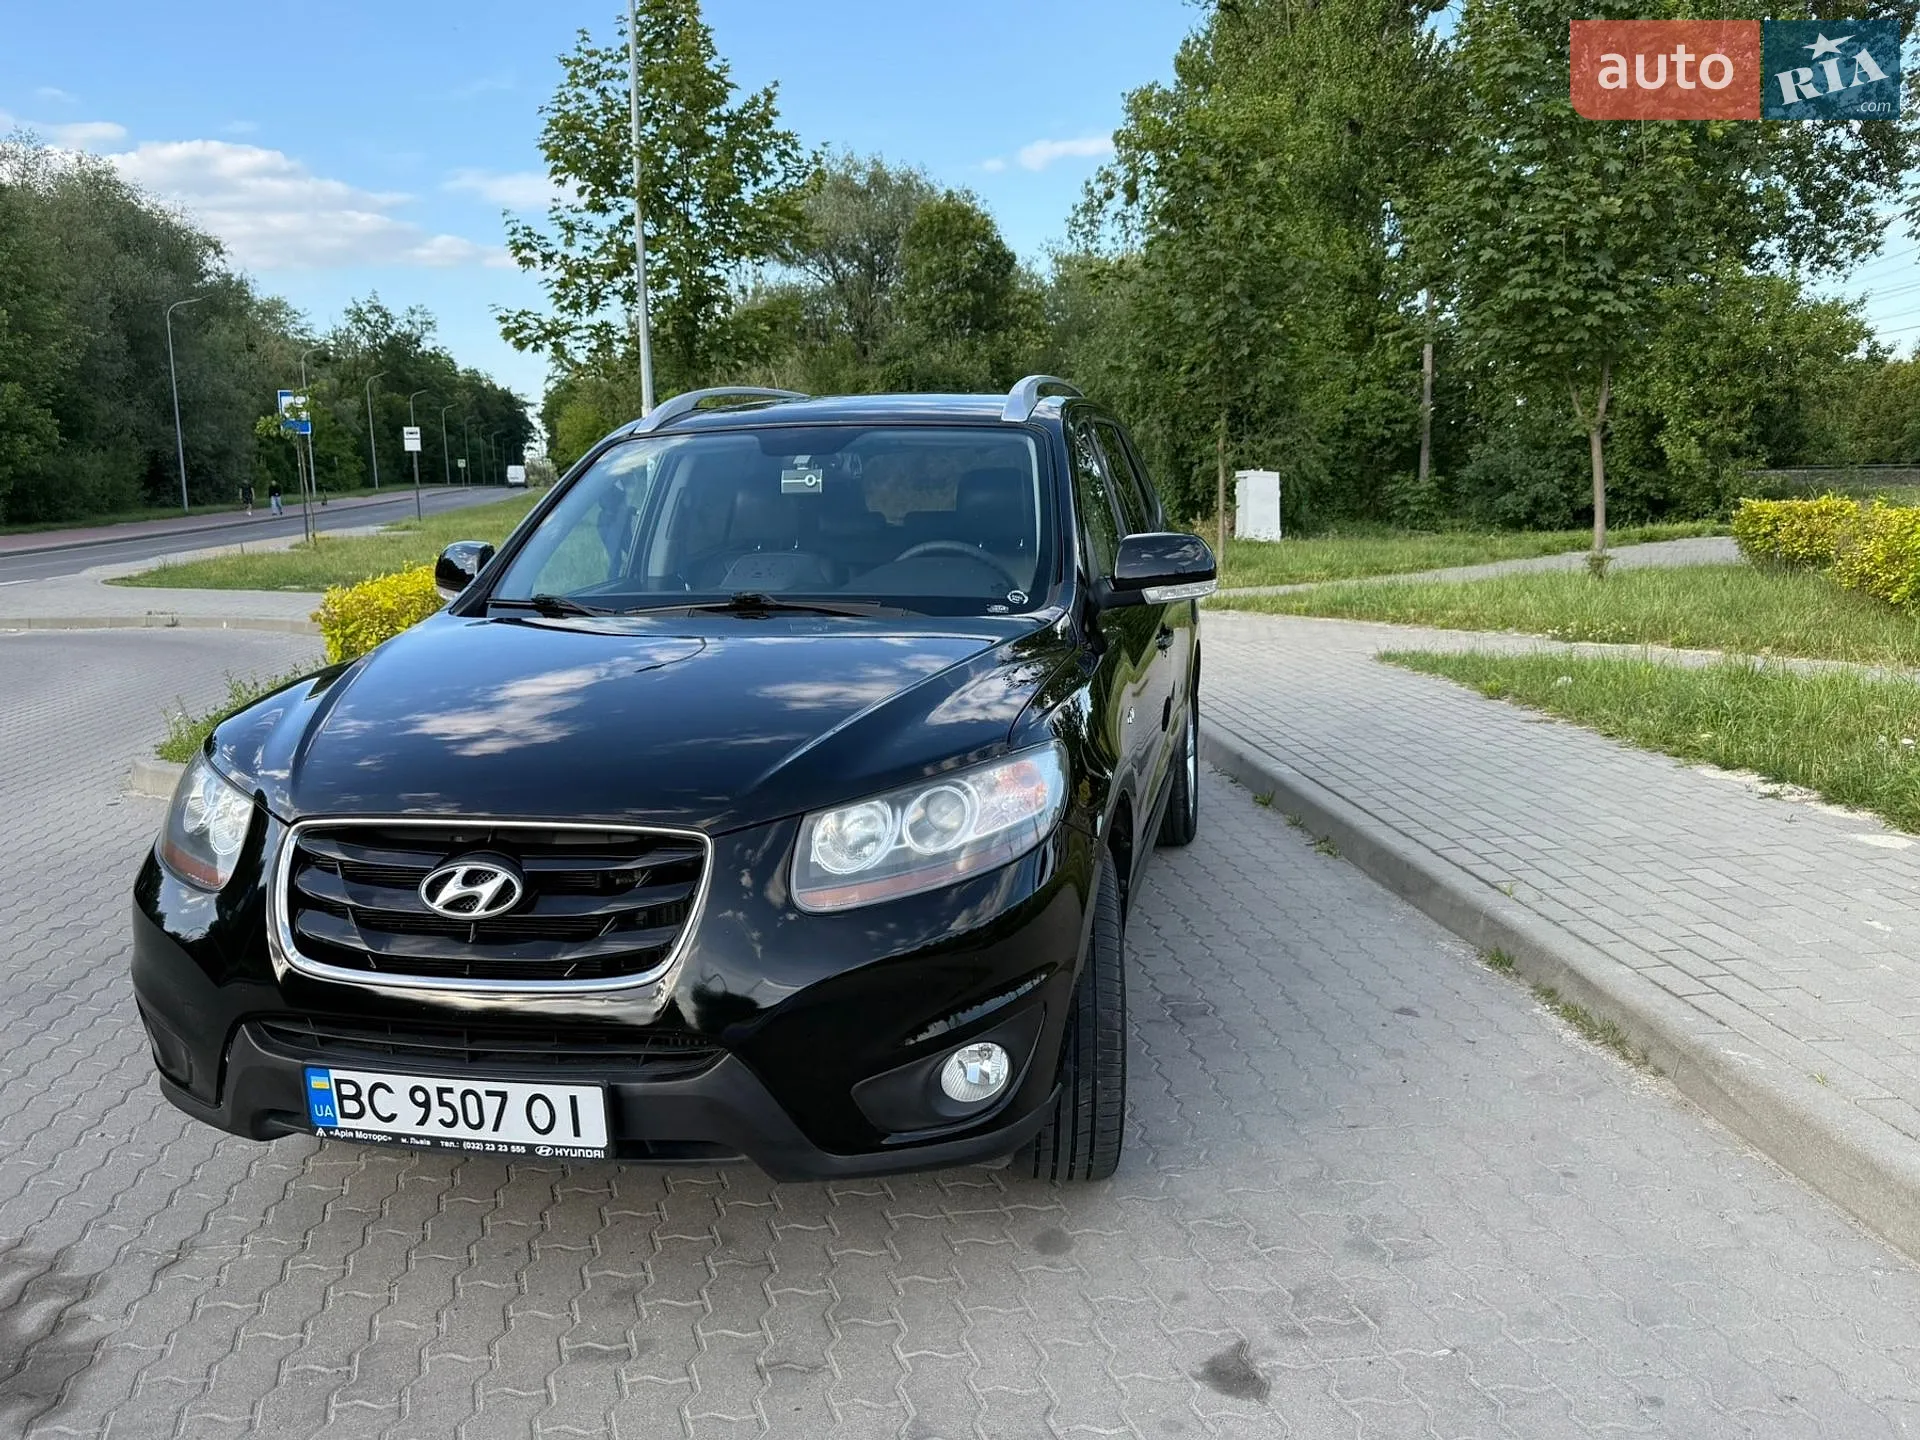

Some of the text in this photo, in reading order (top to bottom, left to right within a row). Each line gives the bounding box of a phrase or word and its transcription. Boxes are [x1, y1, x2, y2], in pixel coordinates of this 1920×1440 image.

[314, 1103, 335, 1118] UA
[334, 1078, 398, 1123] BC
[409, 1085, 508, 1133] 9507
[555, 1148, 605, 1159] HYUNDAI
